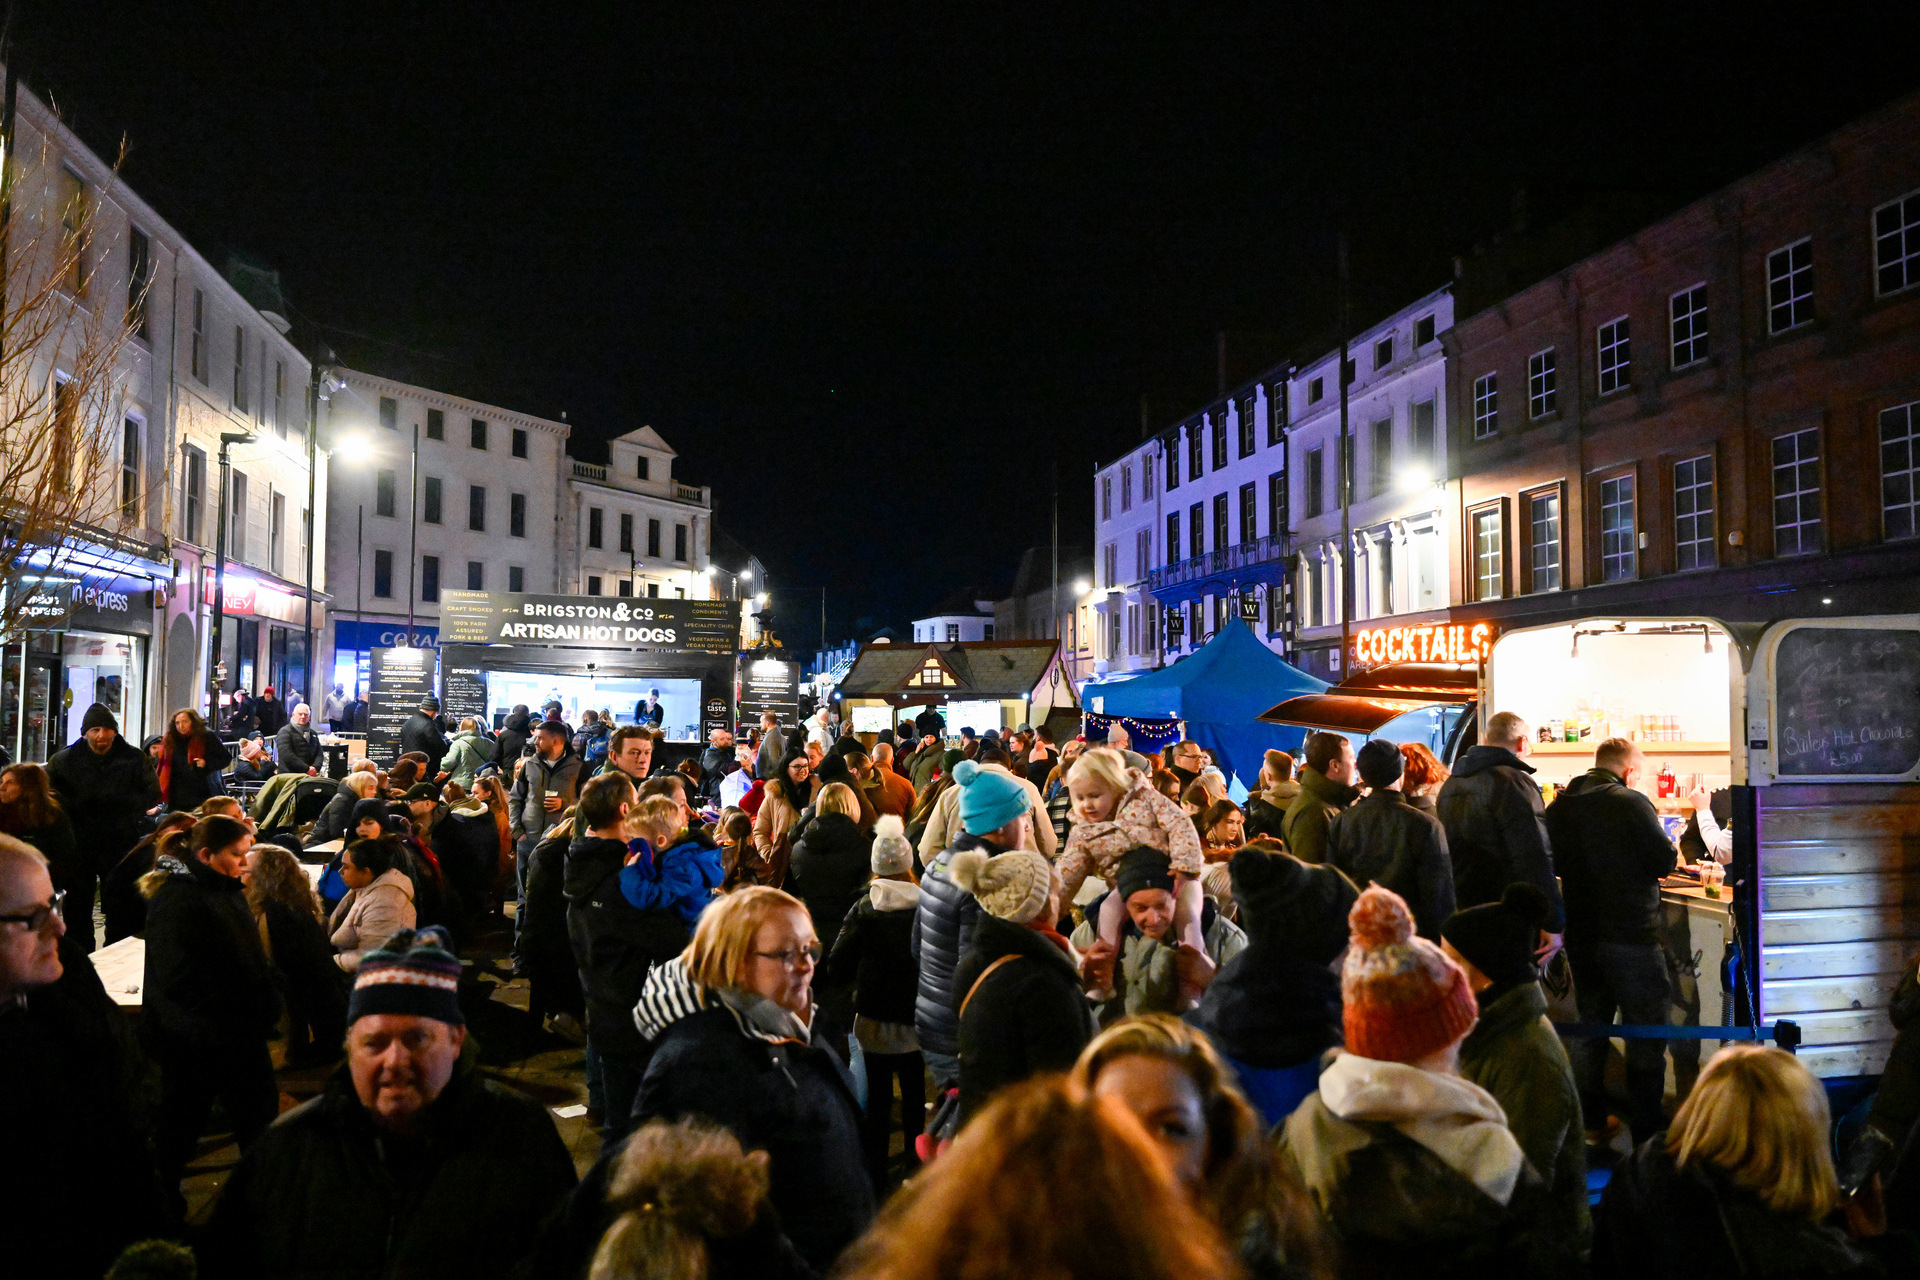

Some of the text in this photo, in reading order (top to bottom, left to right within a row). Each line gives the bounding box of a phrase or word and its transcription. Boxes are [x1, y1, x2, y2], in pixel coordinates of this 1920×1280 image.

[523, 603, 611, 620] BRIGSTON
[1244, 604, 1257, 614] W
[1170, 619, 1181, 629] W
[380, 631, 441, 648] CORAL
[499, 623, 677, 643] ARTISAN HOT DOGS
[1356, 624, 1489, 662] COCKTAILS
[707, 704, 727, 712] taste
